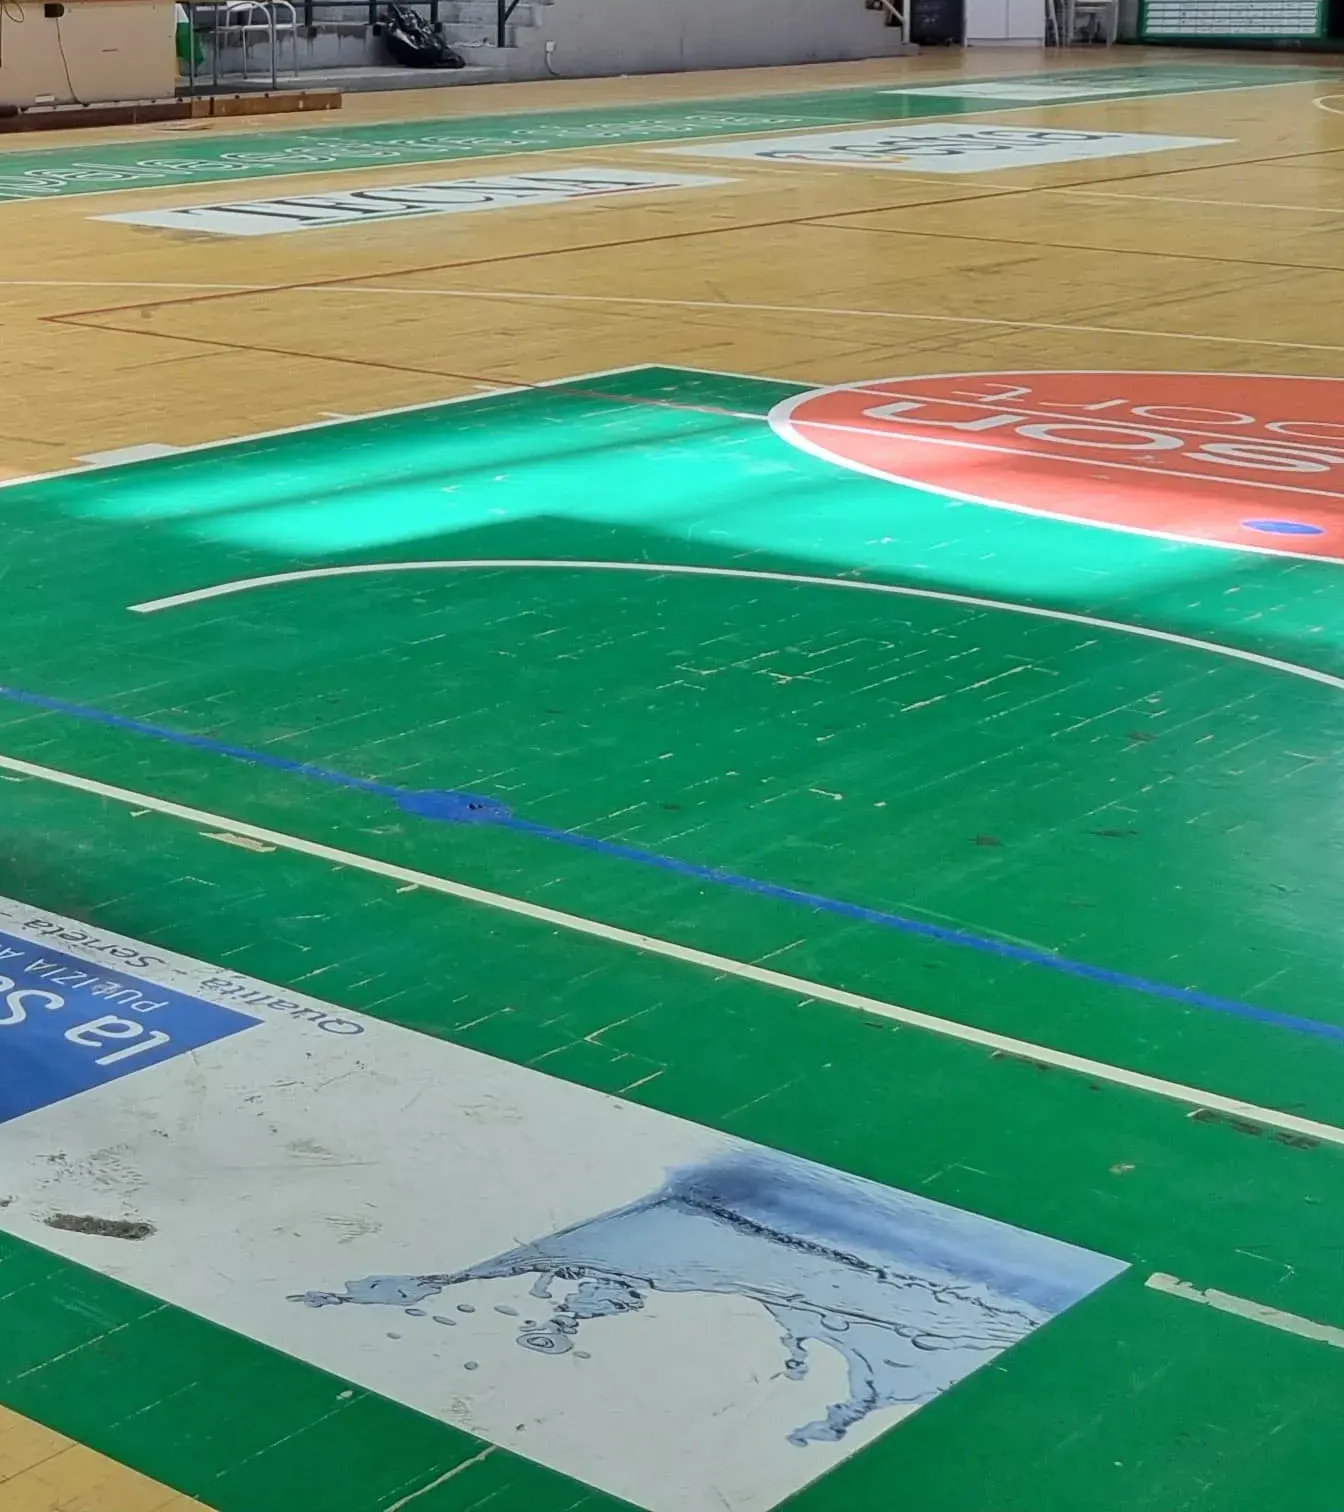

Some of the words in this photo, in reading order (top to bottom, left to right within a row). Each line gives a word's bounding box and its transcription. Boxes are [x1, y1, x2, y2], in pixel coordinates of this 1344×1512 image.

[170, 174, 652, 222] TECNA
[22, 918, 167, 974] Serietà
[200, 975, 367, 1039] Qualità
[63, 1012, 172, 1068] la
